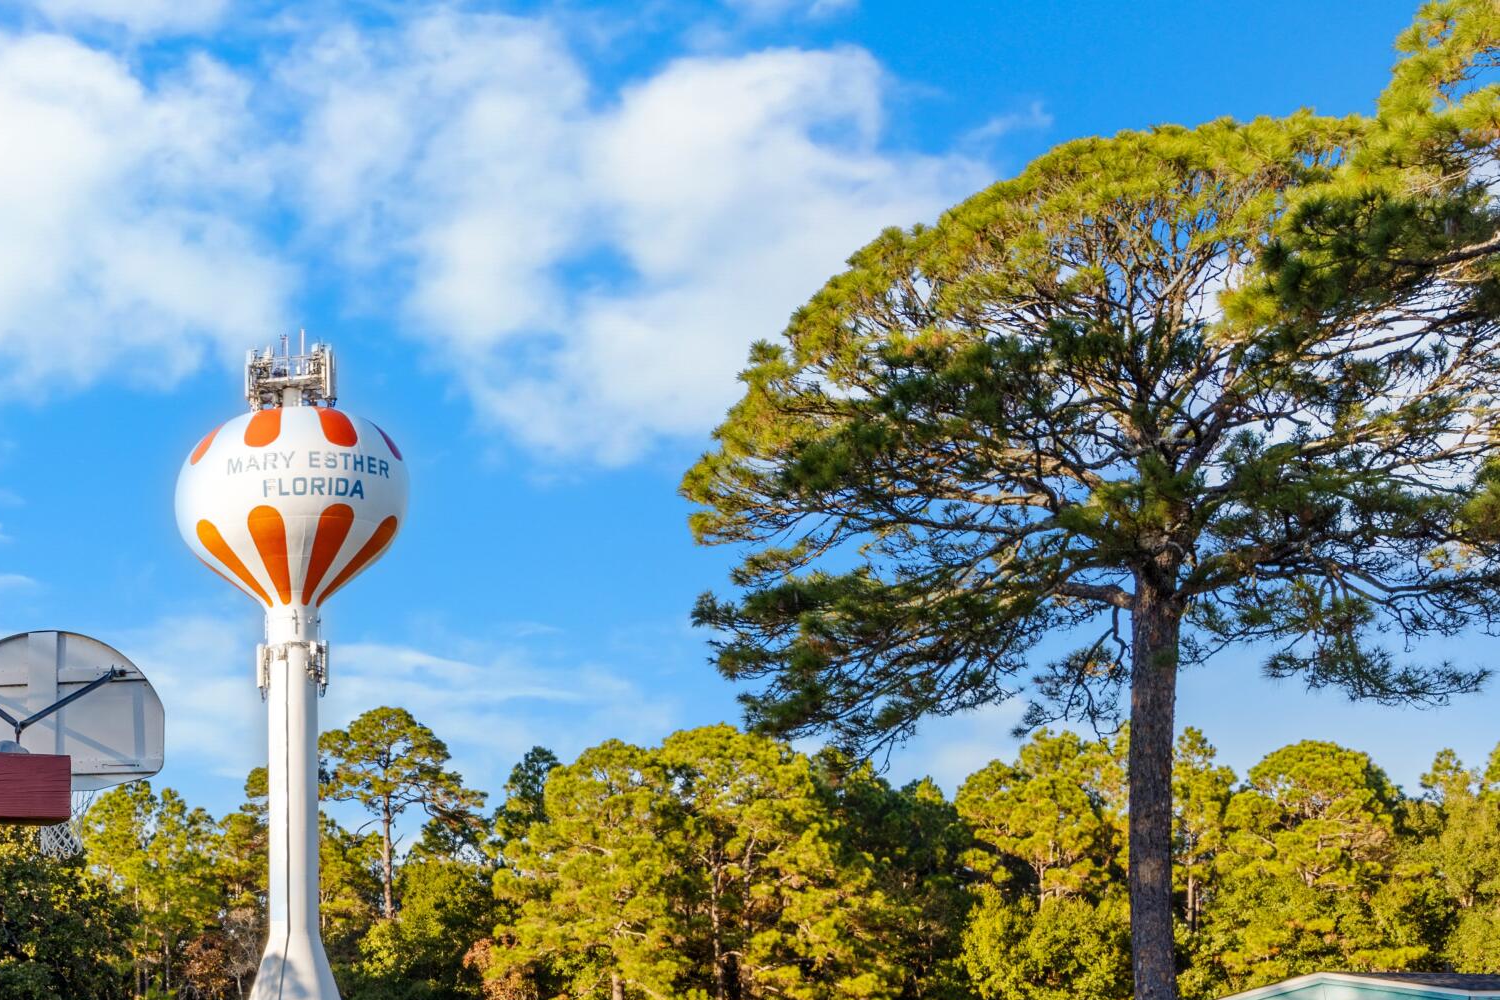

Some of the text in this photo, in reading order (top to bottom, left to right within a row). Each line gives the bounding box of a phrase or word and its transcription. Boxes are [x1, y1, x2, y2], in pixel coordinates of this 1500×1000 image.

[227, 451, 390, 478] MARY ESTHER
[263, 477, 364, 499] FLORIDA
